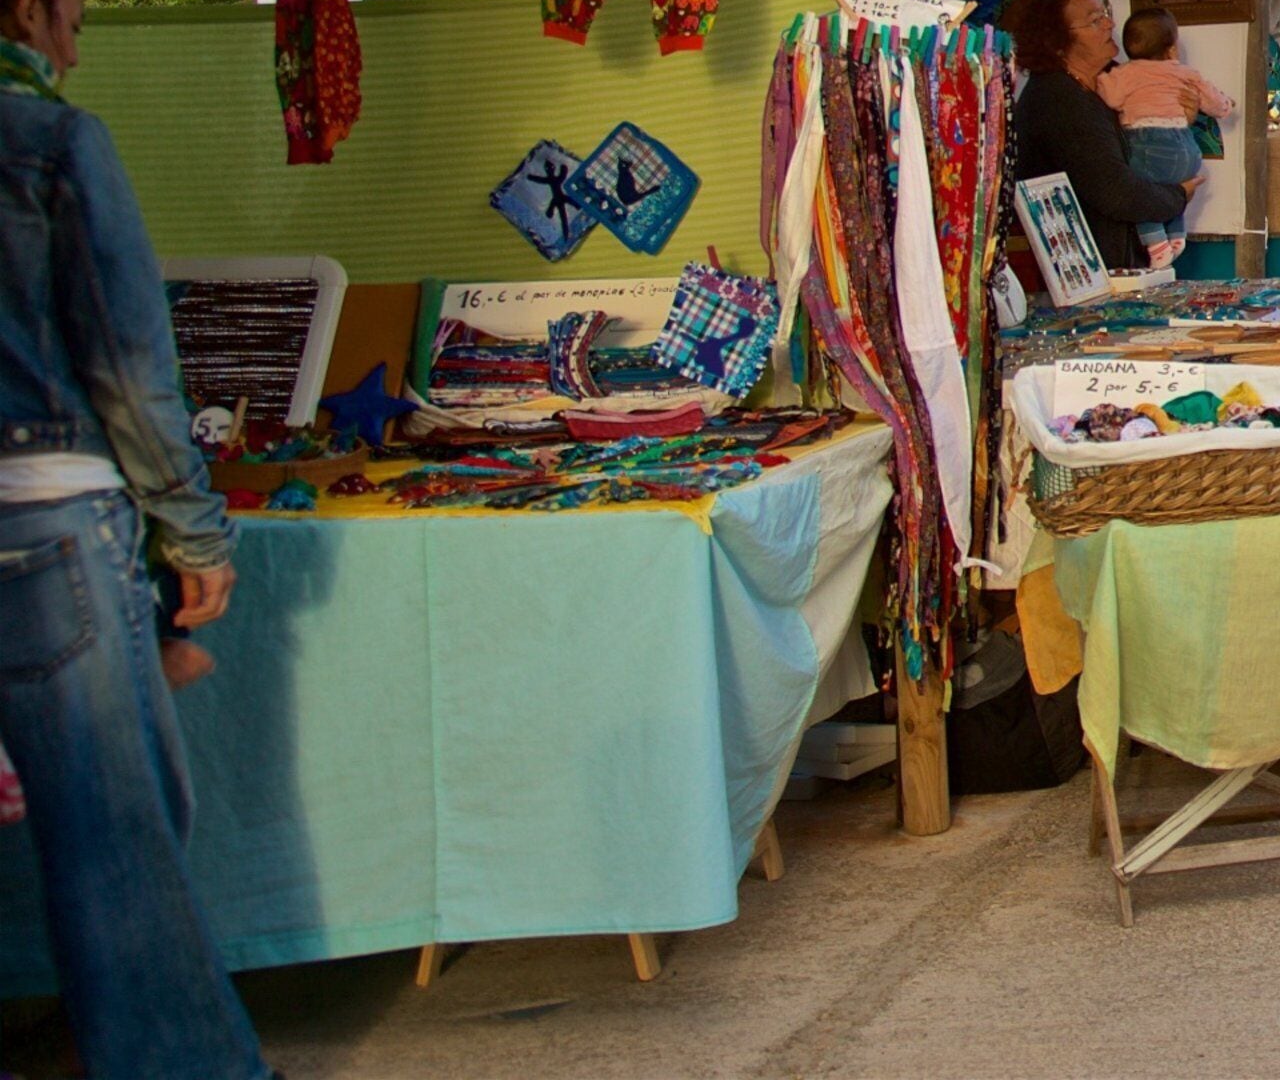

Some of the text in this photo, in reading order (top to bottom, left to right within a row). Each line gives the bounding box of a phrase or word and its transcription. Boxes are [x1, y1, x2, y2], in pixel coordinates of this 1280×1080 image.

[1061, 362, 1137, 374] BANDANA
[1086, 377, 1100, 393] 2
[1104, 383, 1128, 398] por
